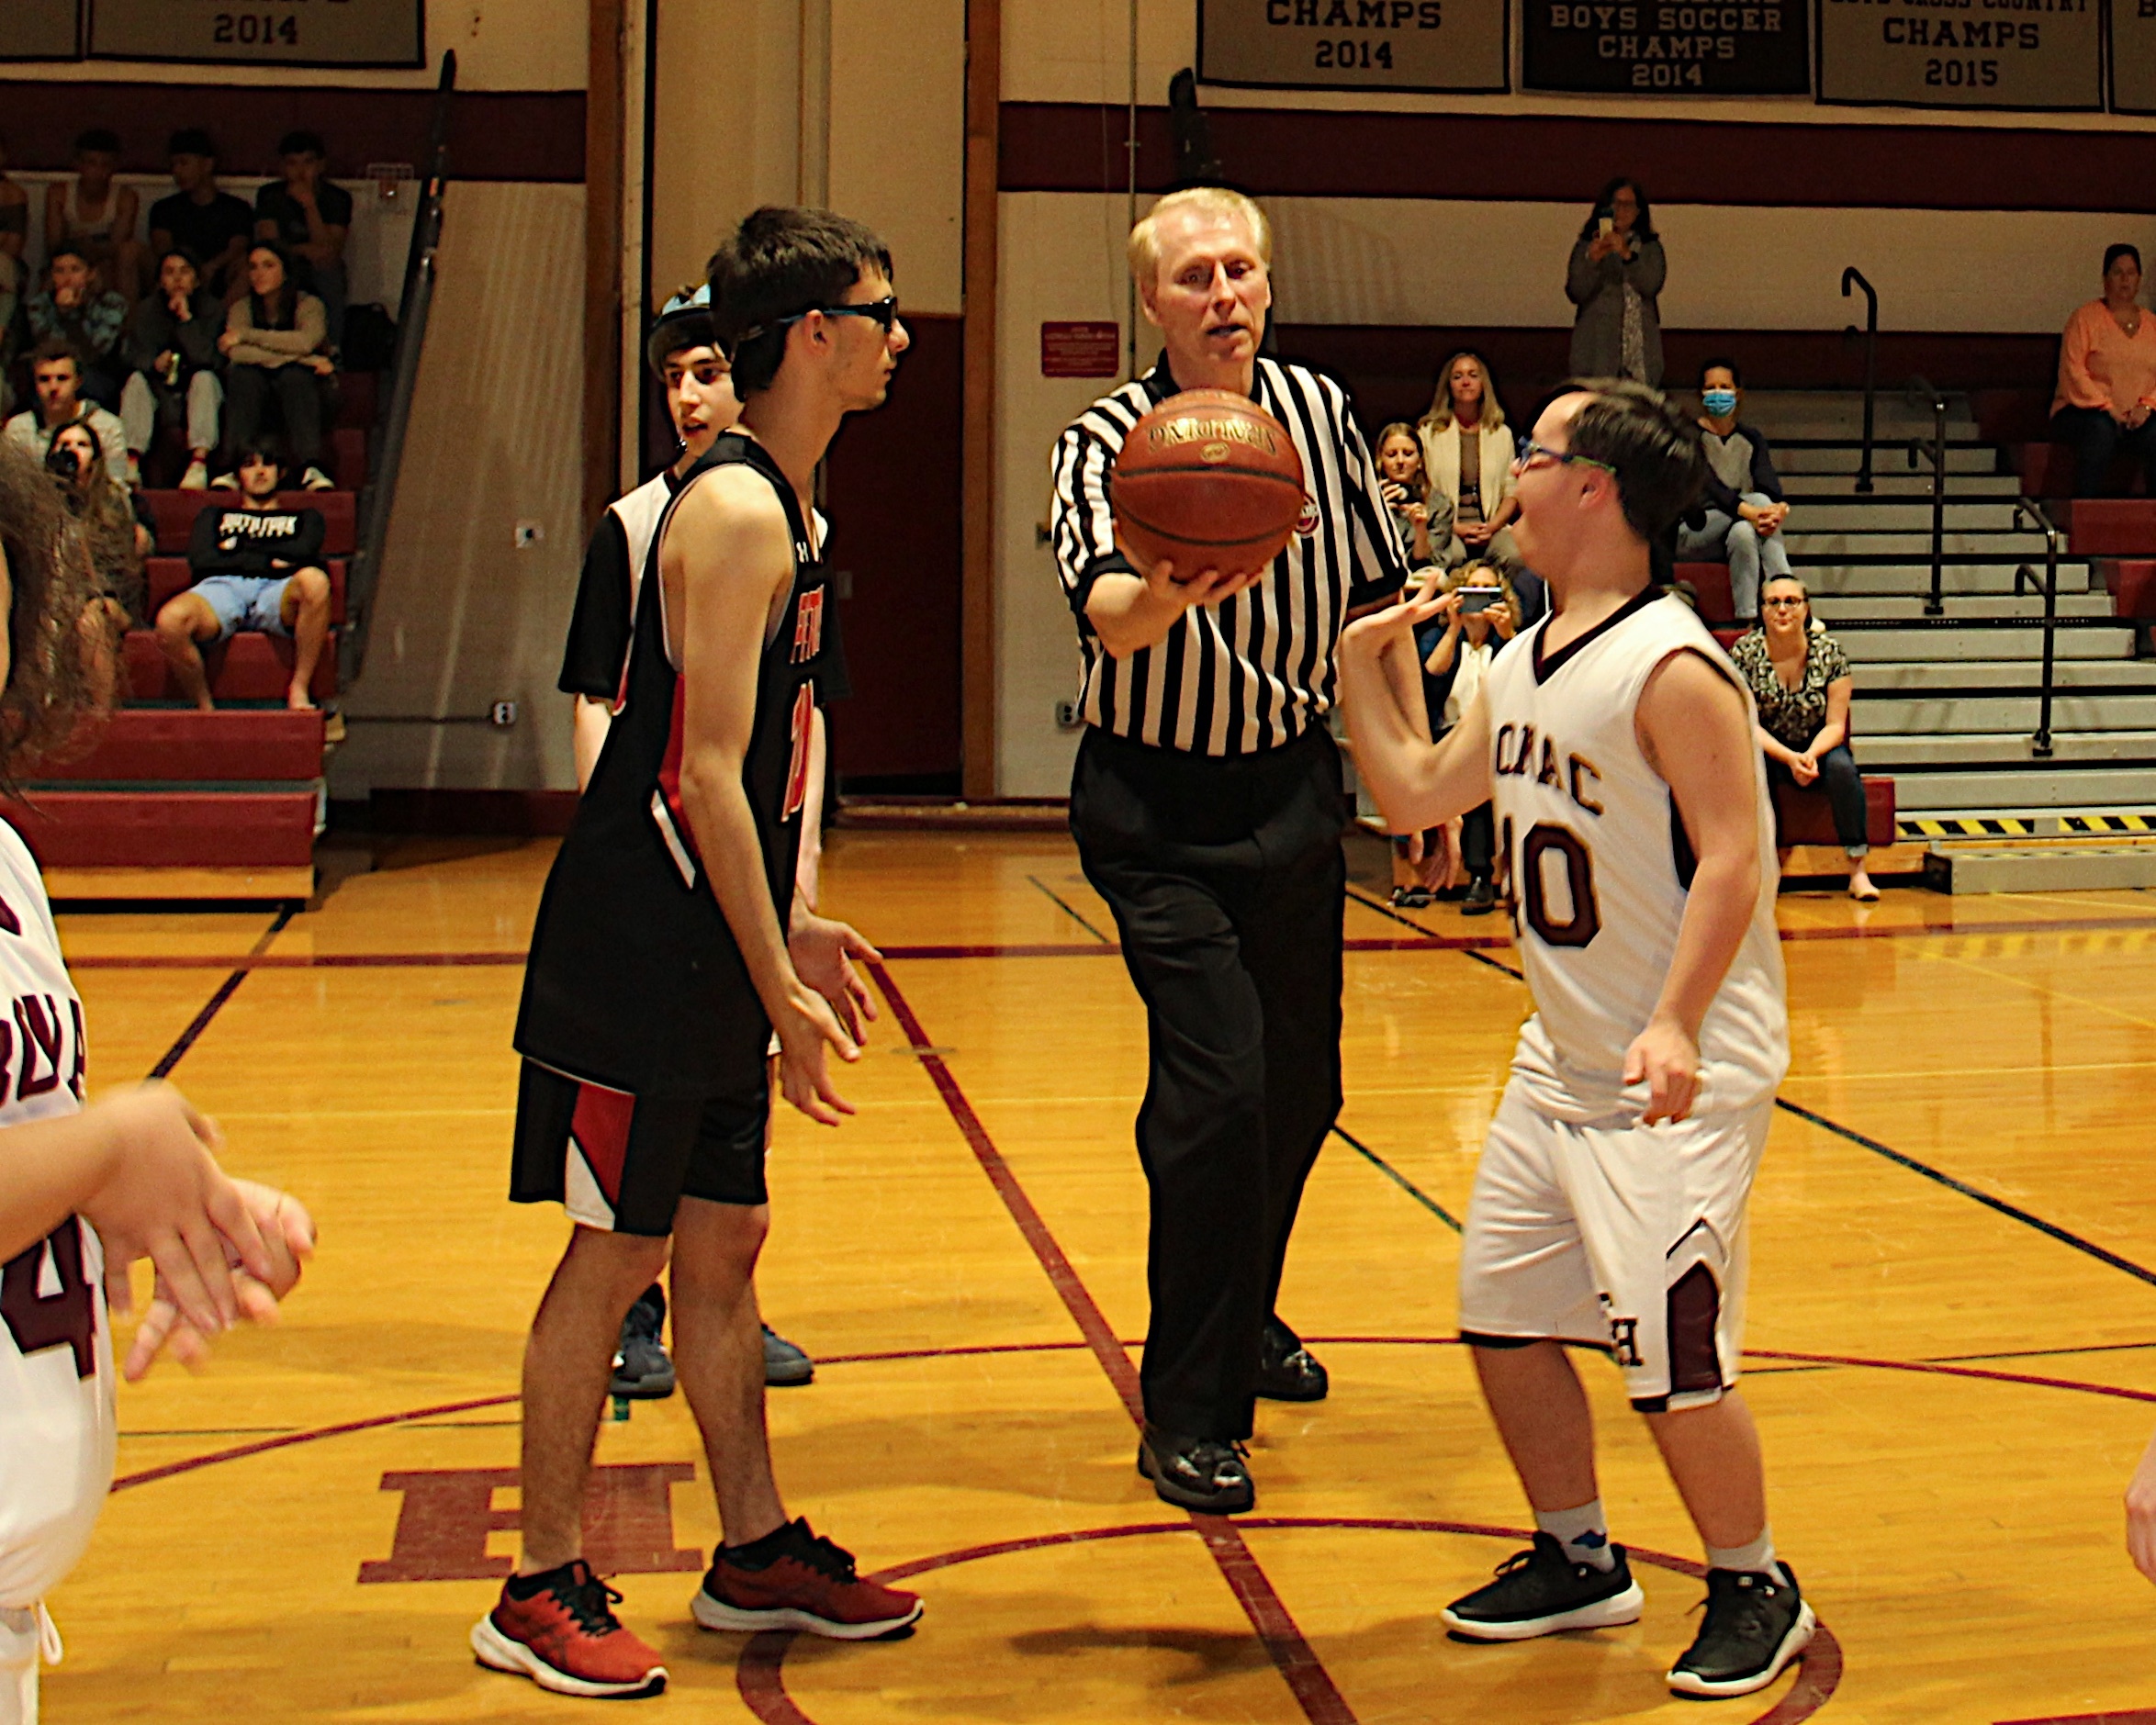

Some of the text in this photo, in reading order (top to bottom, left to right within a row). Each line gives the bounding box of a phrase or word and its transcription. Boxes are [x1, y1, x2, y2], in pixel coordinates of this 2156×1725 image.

[1267, 0, 1441, 29] CHAMPS
[1551, 6, 1781, 31] BOYS SOCCER
[214, 15, 298, 44] 2014
[1883, 17, 2039, 50] CHAMPS
[1315, 40, 1393, 69] 2014
[1598, 36, 1735, 59] CHAMPS
[1632, 63, 1703, 86] 2014
[1926, 60, 1998, 86] 2015
